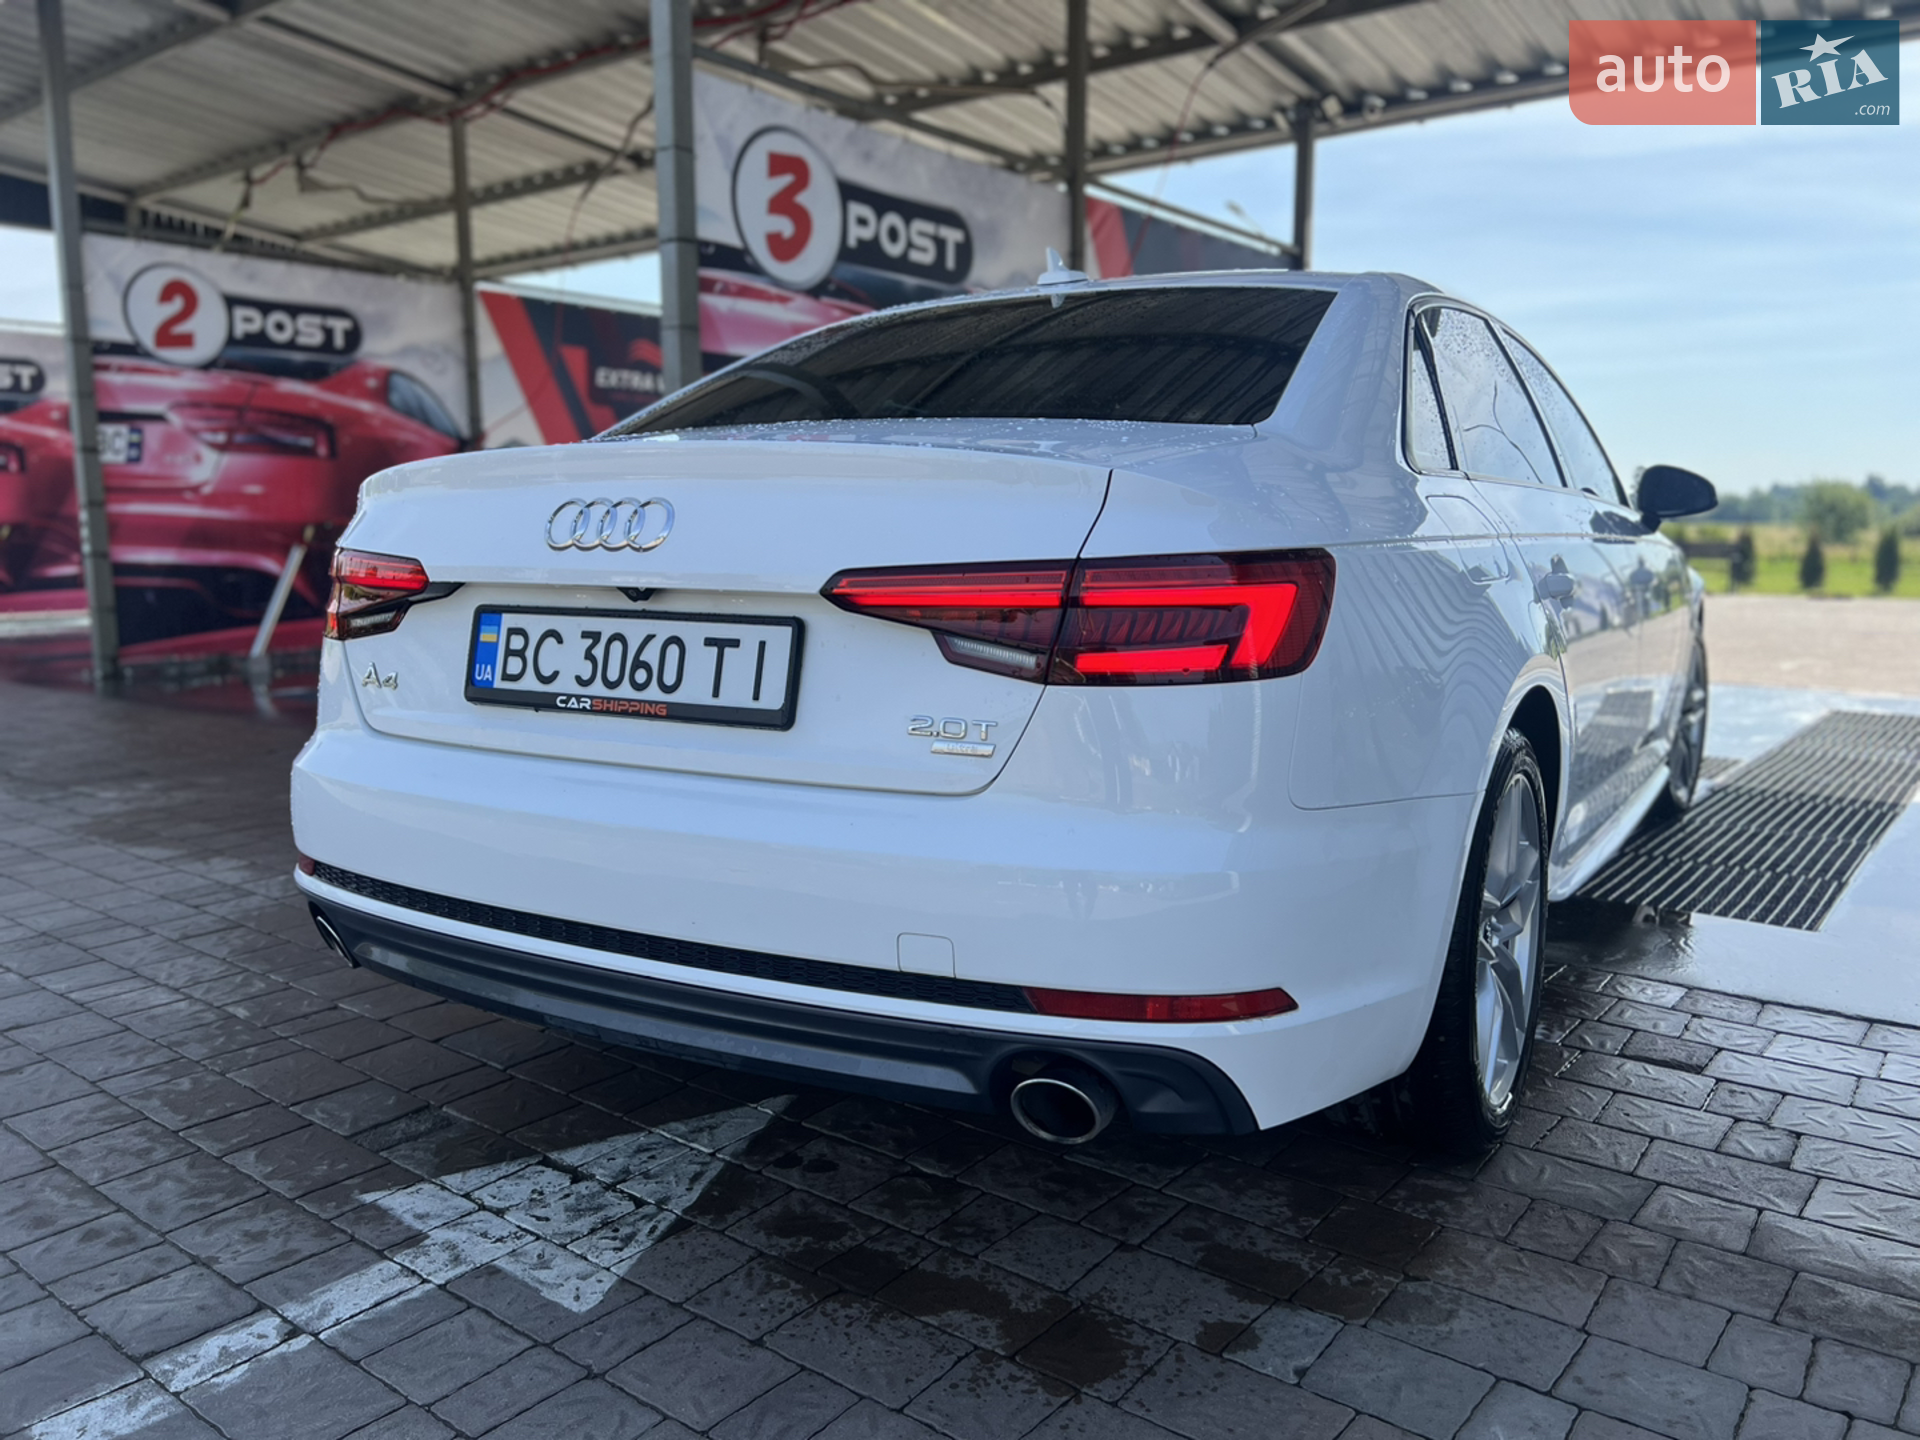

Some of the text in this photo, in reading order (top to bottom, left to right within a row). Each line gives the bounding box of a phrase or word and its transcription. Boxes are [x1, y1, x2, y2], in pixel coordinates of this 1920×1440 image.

[765, 151, 966, 271] 3 POST
[154, 279, 353, 350] 2 POST
[362, 660, 399, 691] A4
[474, 664, 493, 682] UA
[574, 630, 686, 694] 3060
